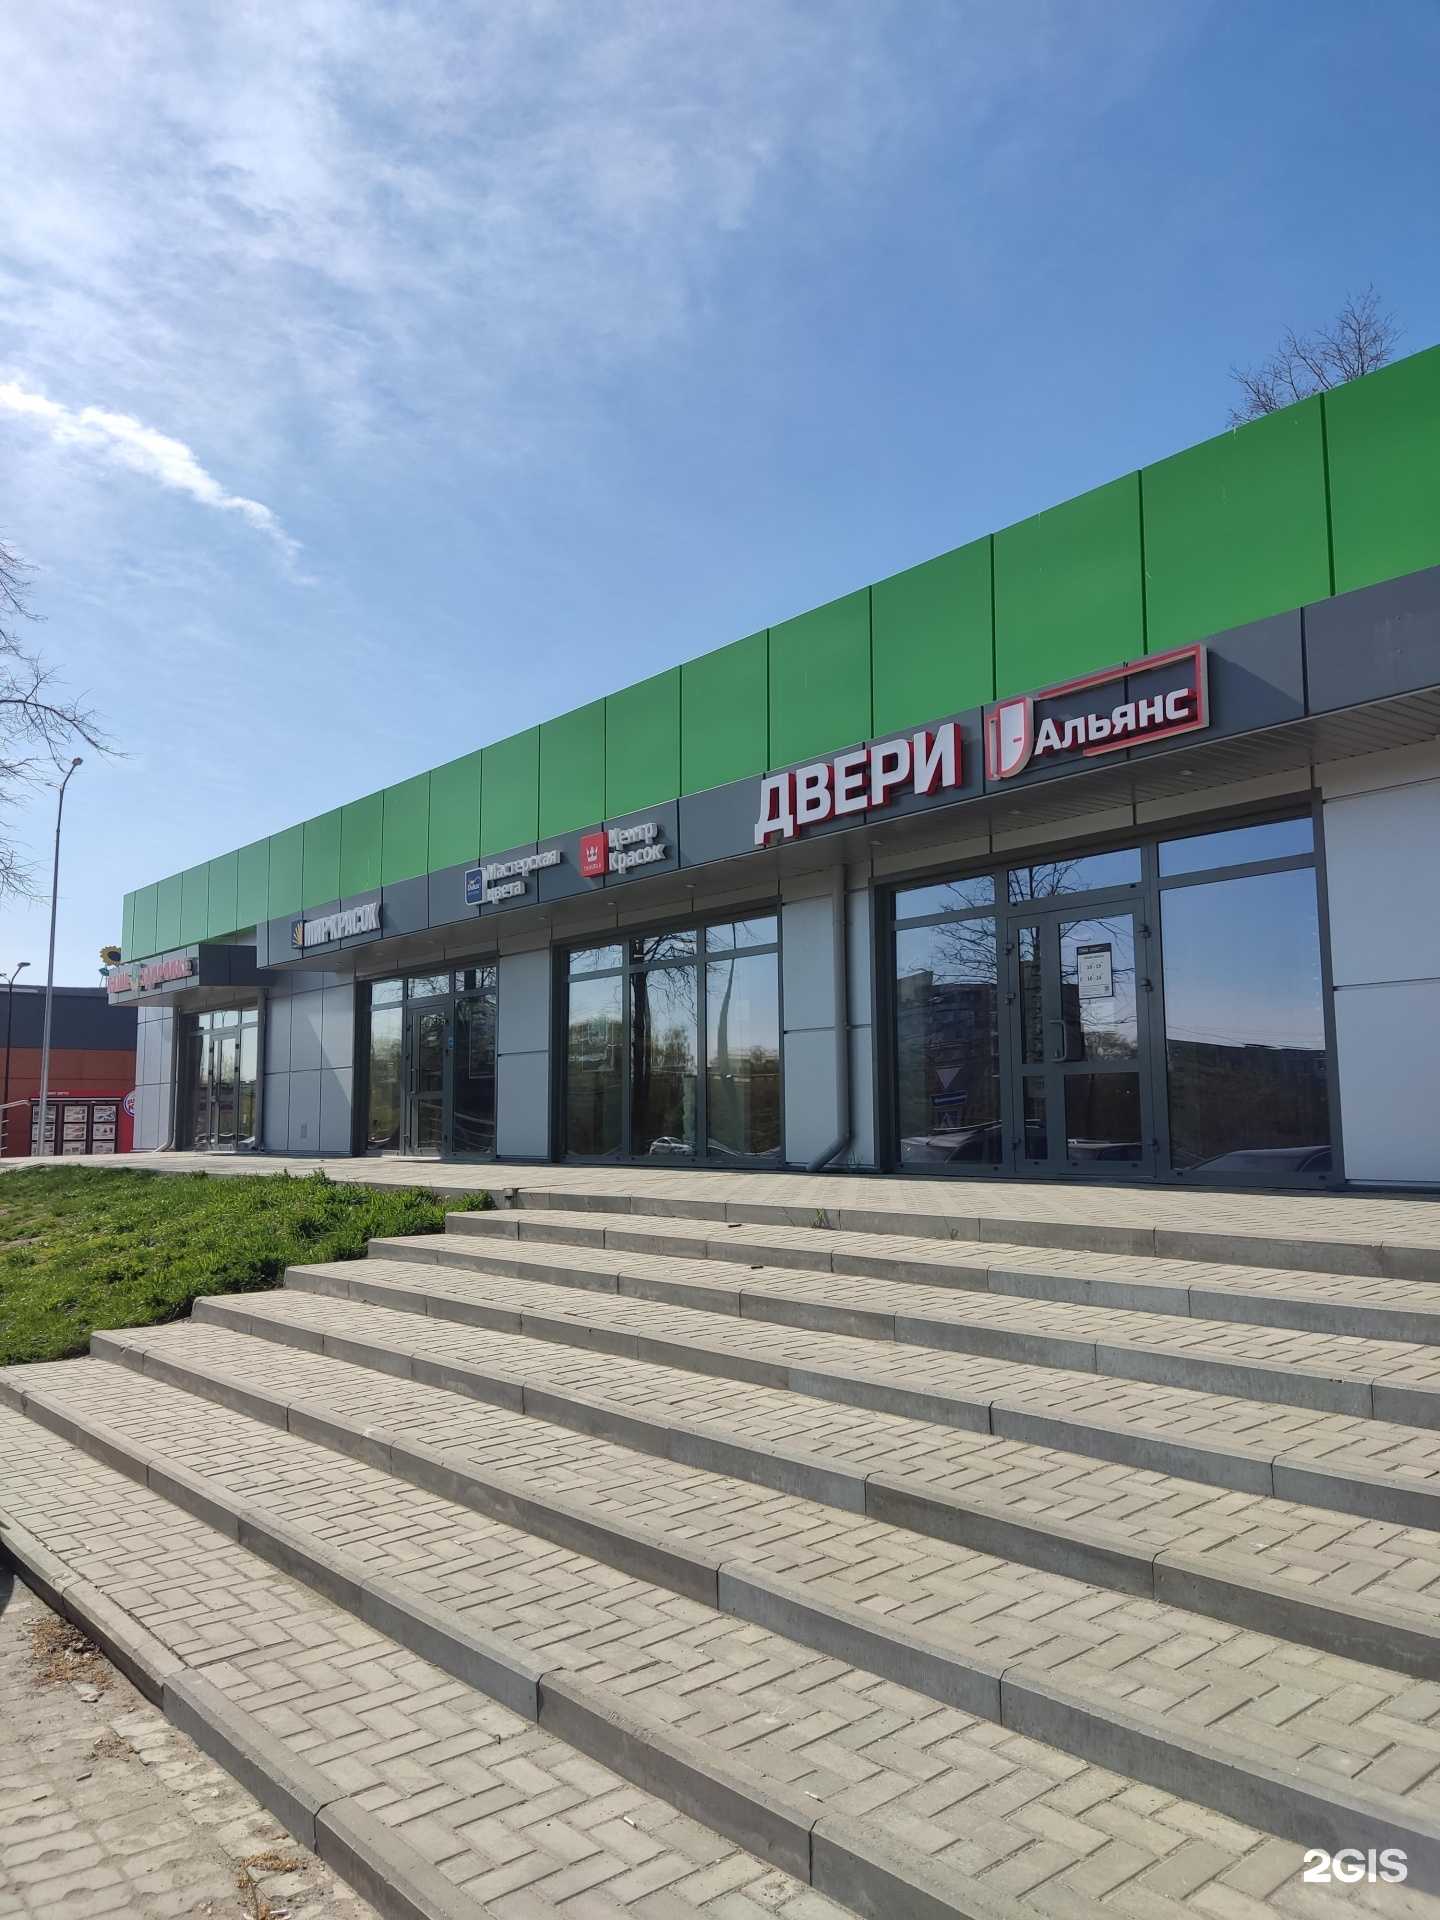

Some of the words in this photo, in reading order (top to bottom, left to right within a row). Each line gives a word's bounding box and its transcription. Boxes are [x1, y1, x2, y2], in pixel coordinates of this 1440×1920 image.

[1034, 688, 1191, 755] Альянс
[754, 721, 961, 846] ДВЕРИ
[608, 822, 658, 849] Центр
[484, 849, 561, 881] Мастерская
[608, 843, 665, 874] Красок
